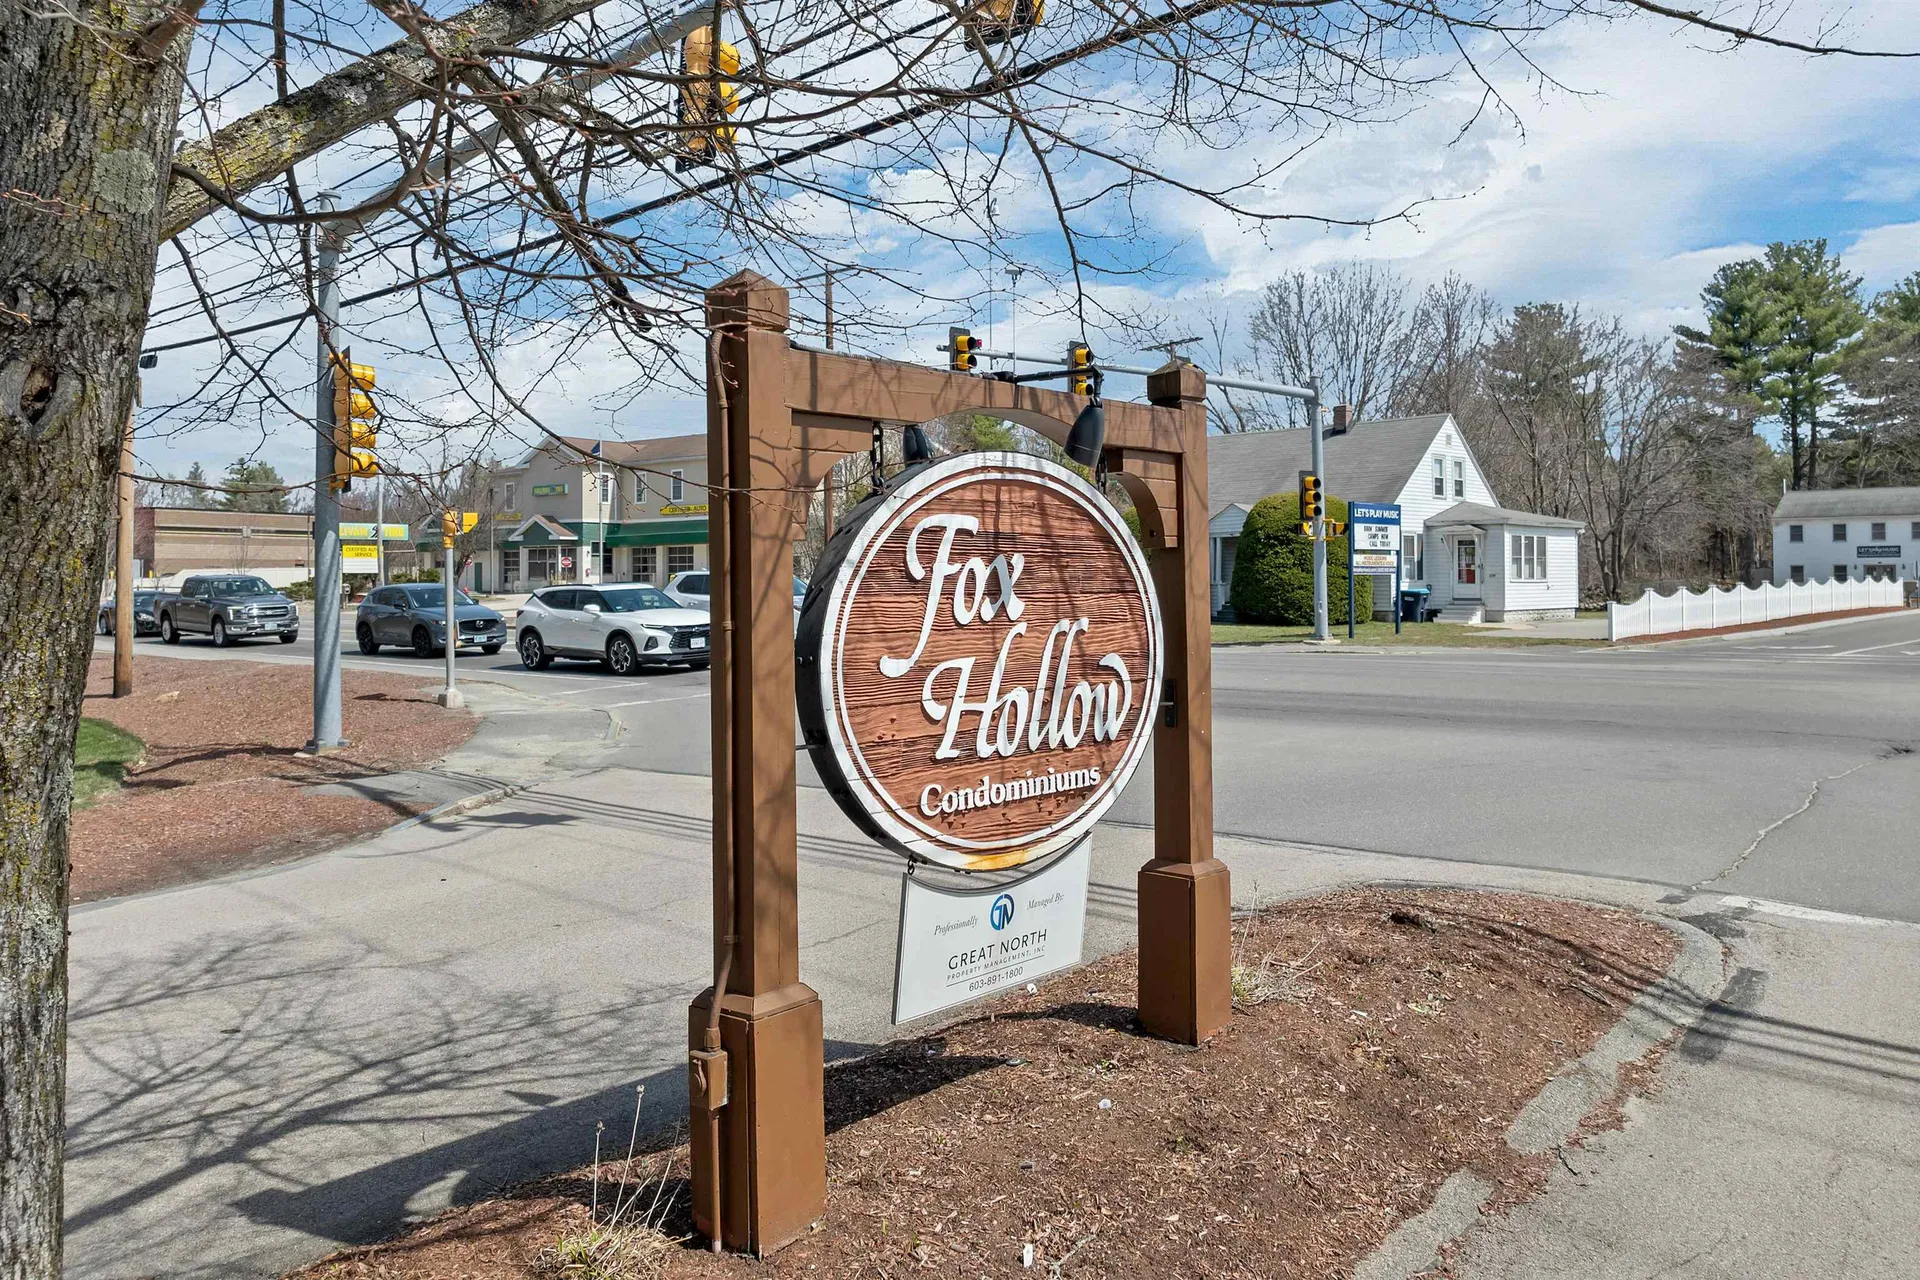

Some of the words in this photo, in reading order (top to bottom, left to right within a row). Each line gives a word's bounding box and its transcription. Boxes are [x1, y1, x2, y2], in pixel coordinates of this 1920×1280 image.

[1370, 510, 1382, 518] PLAY
[1383, 511, 1399, 519] MUSIC
[879, 513, 1026, 678] Fox
[922, 617, 1132, 761] Hollow
[920, 766, 1101, 817] Condominiums
[1026, 896, 1053, 910] Managed
[933, 915, 979, 937] Professionally
[948, 944, 995, 970] GREAT
[1000, 928, 1048, 955] NORTH
[946, 965, 982, 981] PROPERTY
[984, 950, 1031, 969] MANAGEMENT,
[968, 965, 1024, 992] 603-891-1800
